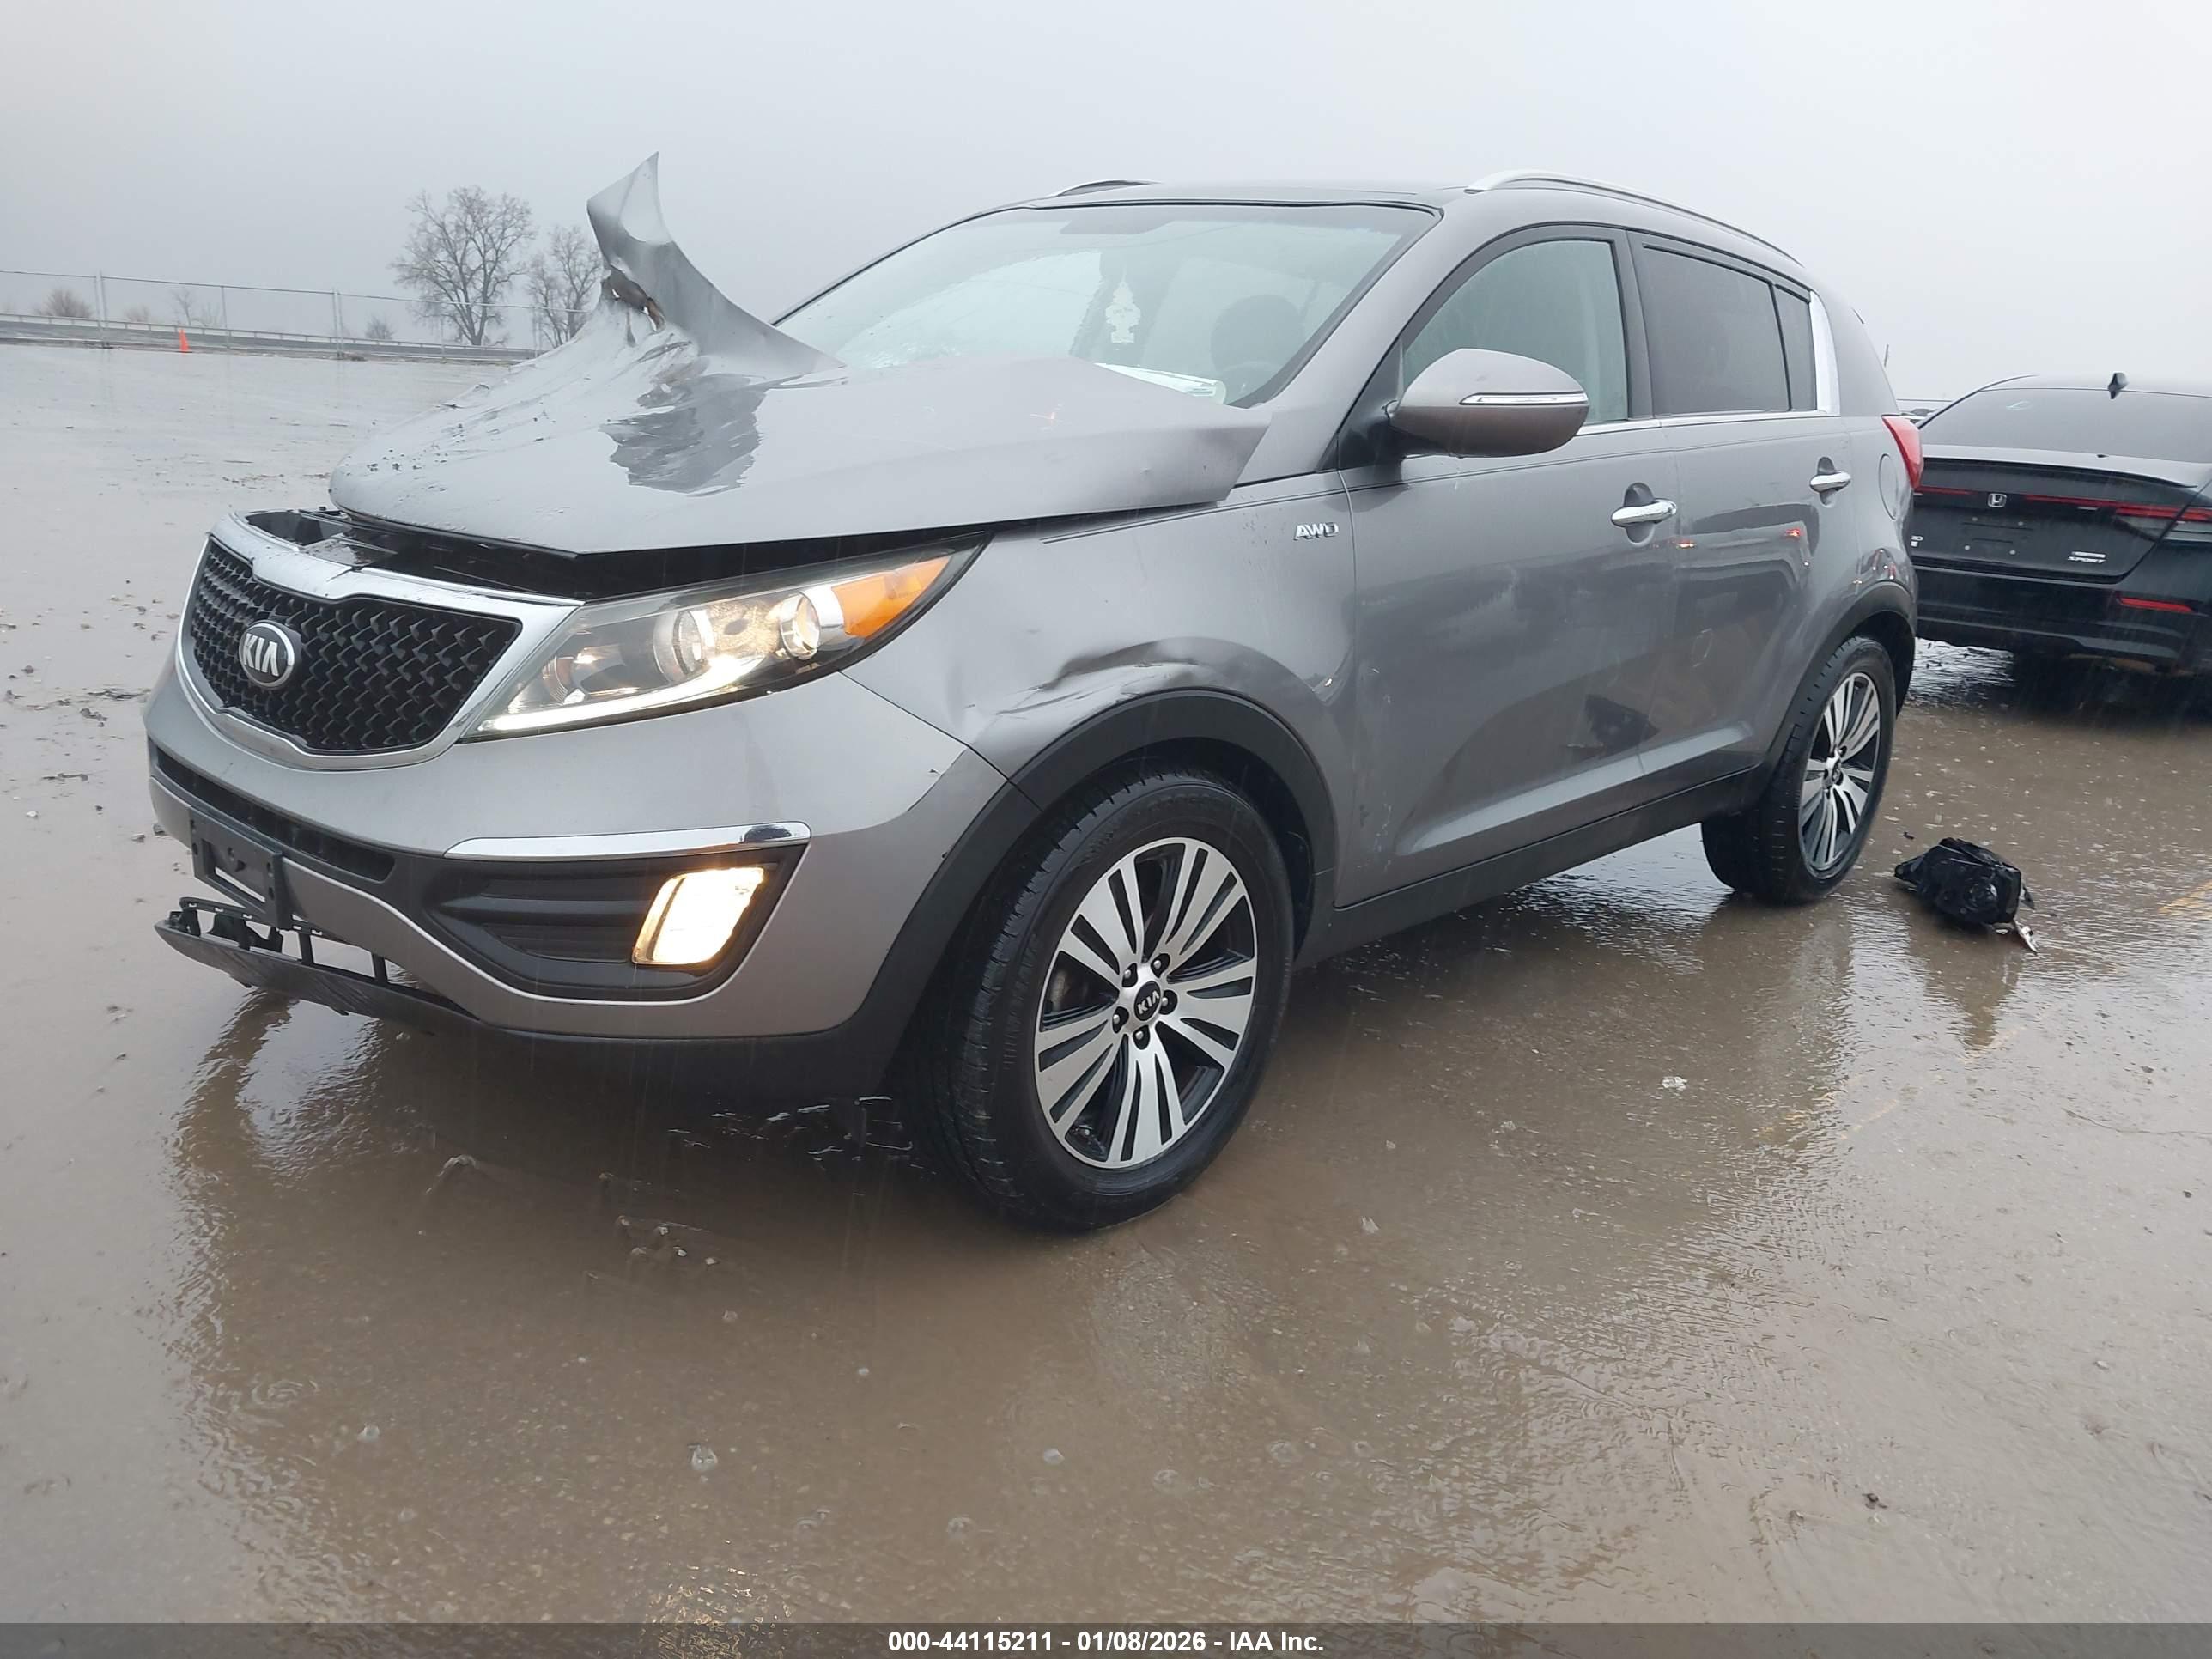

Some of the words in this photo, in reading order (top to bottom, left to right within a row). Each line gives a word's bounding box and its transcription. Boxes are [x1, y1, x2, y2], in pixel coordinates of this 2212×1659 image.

[1294, 523, 1340, 541] AWD
[243, 633, 279, 677] KIA
[1137, 990, 1159, 1014] KIA
